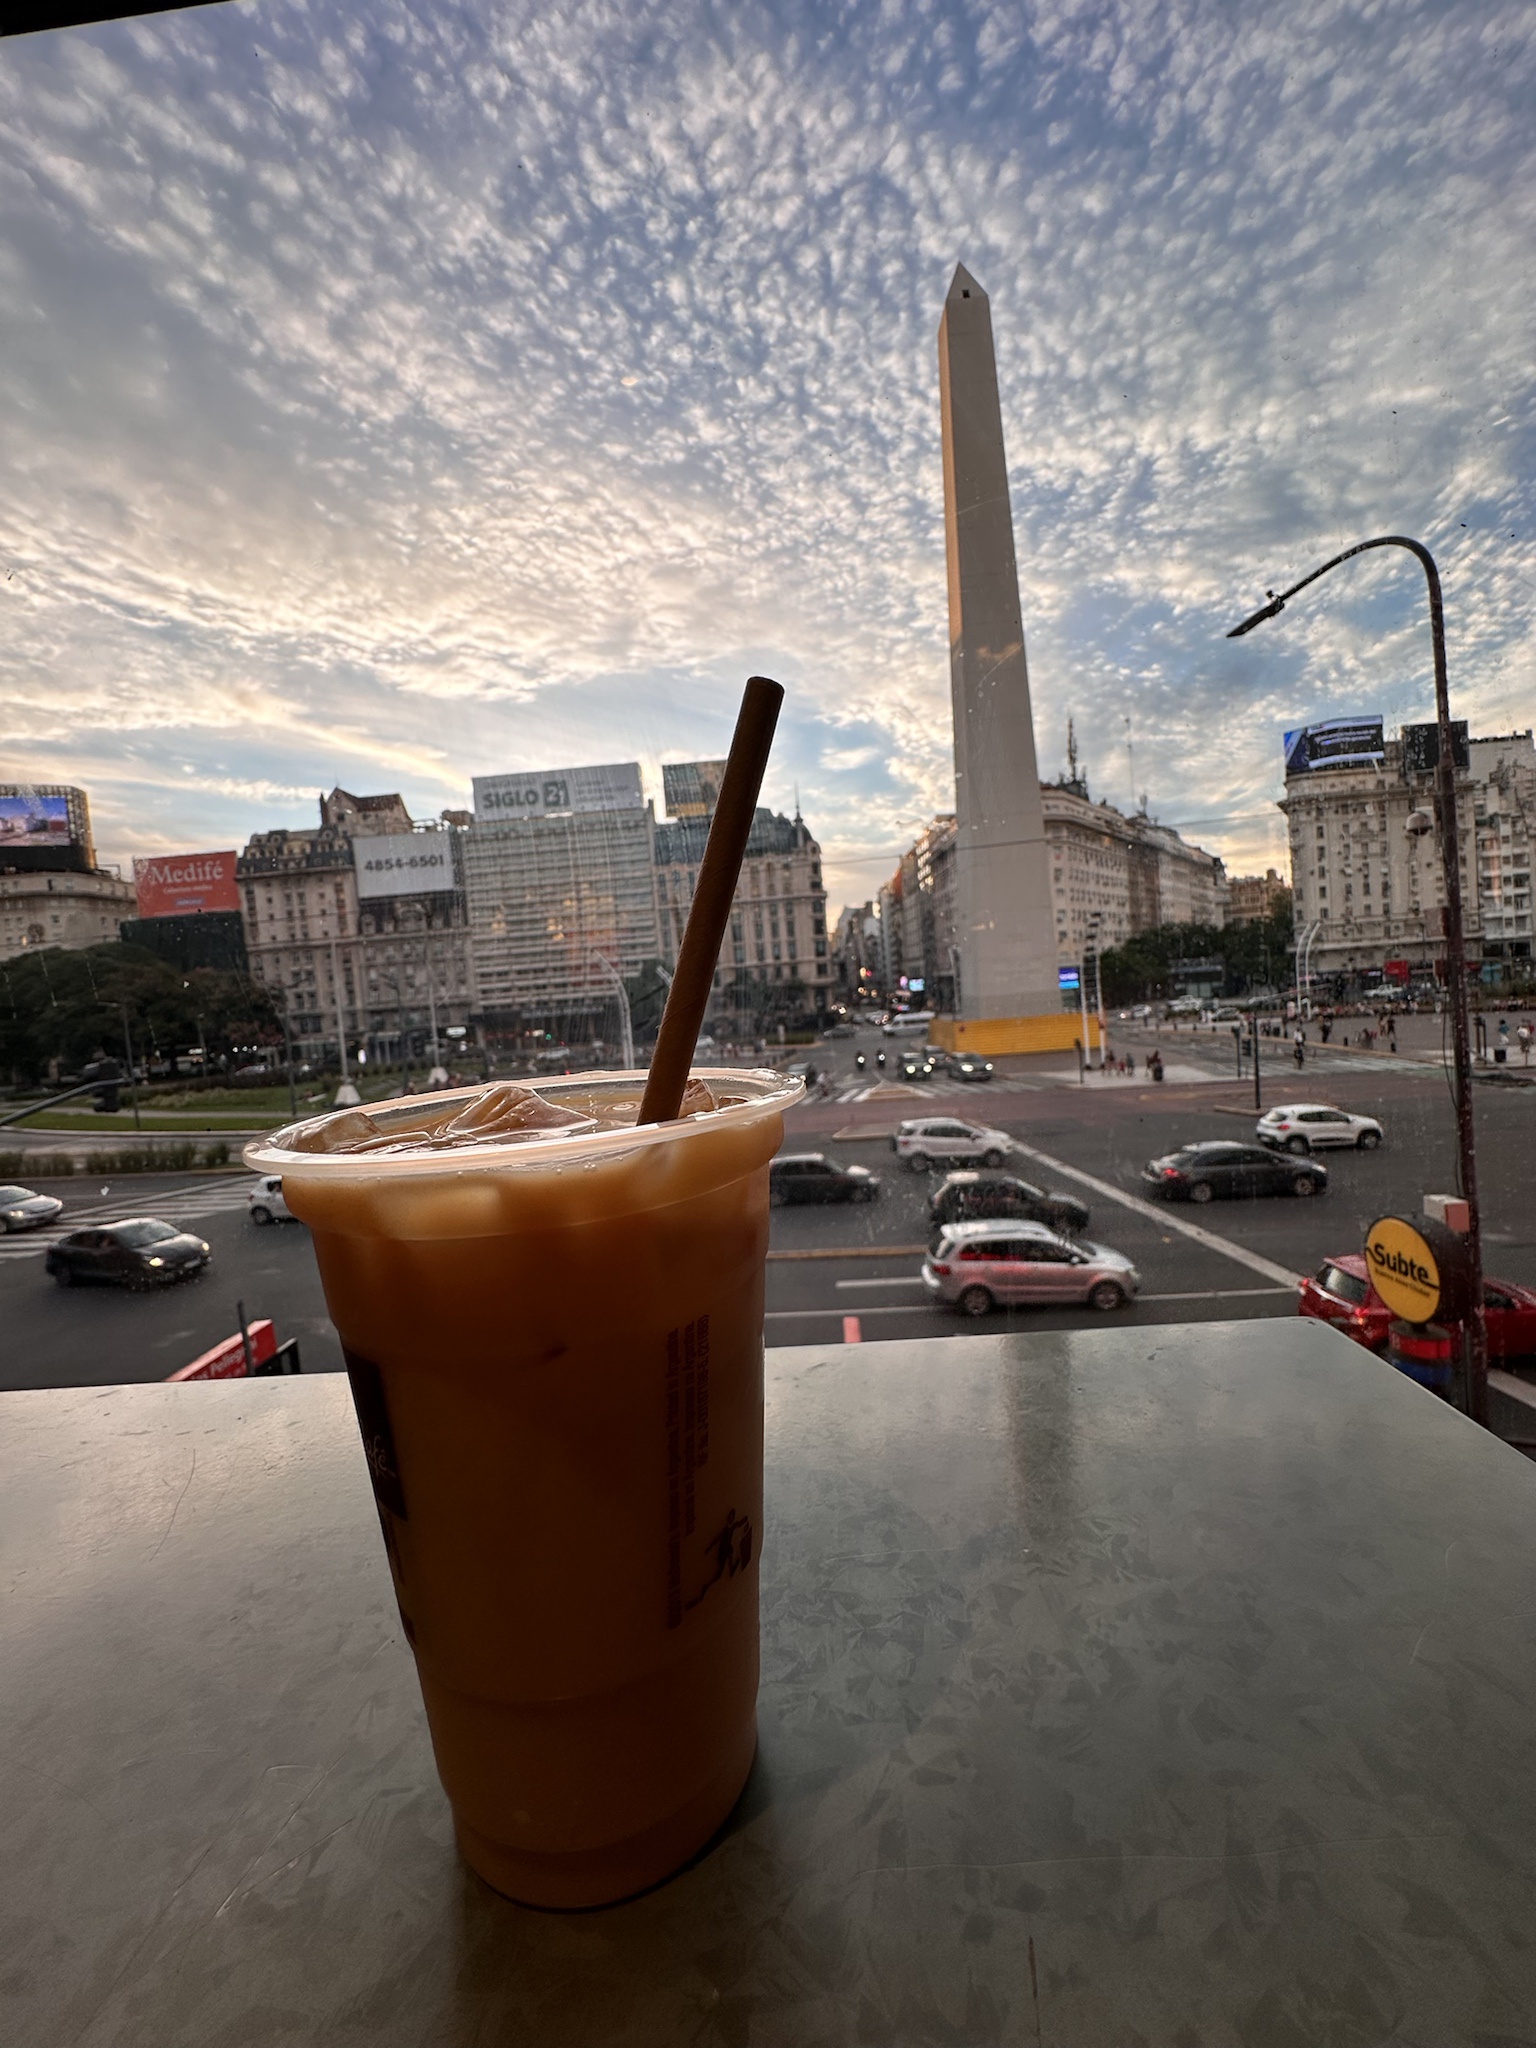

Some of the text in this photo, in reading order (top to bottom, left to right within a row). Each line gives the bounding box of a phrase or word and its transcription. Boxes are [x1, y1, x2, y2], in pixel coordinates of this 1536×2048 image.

[483, 789, 539, 809] SIGLO
[150, 860, 224, 886] Medifé
[364, 854, 445, 873] 4854-6501
[1367, 1242, 1436, 1287] Subte
[210, 1337, 259, 1377] Pellegrni
[365, 1435, 397, 1480] afé
